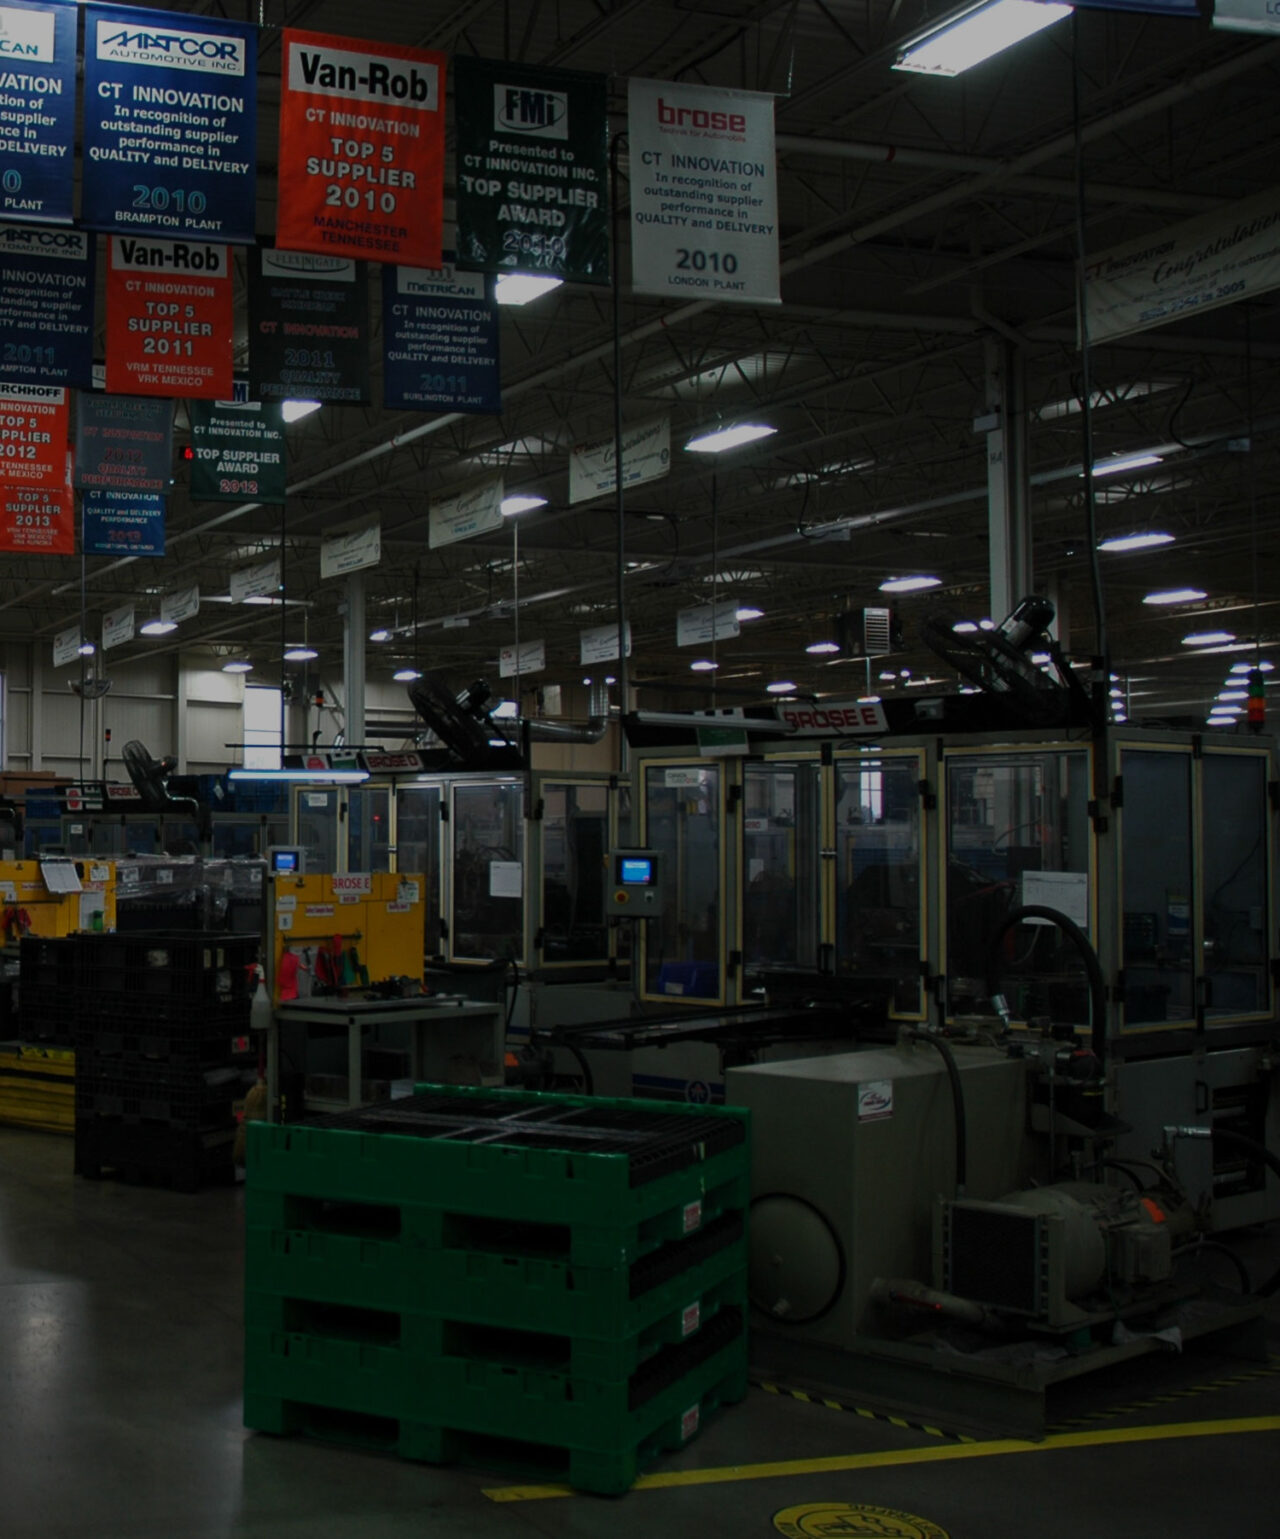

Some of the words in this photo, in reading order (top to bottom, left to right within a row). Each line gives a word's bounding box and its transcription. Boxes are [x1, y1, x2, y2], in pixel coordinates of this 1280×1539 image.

[103, 30, 238, 62] MATCOR
[110, 48, 206, 68] AUTOMOTIVE
[211, 61, 240, 72] INC.
[300, 52, 427, 101] Van-Rob
[29, 98, 43, 110] of
[98, 81, 123, 99] CT
[133, 85, 243, 113] INNOVATION
[1, 110, 56, 127] supplier
[306, 108, 326, 124] CT
[330, 111, 419, 138] INNOVATION
[657, 98, 745, 133] brose
[24, 127, 37, 138] in
[331, 138, 375, 159] TOP
[382, 145, 393, 162] 5
[489, 139, 556, 160] Presented
[560, 148, 574, 160] to
[307, 157, 416, 189] SUPPLIER
[464, 154, 482, 169] CT
[486, 156, 567, 179] INNOVATION
[572, 166, 599, 182] INC.
[641, 151, 663, 166] CT
[671, 154, 765, 178] INNOVATION
[133, 184, 206, 214] 2010
[326, 184, 397, 214] 2010
[464, 176, 501, 197] TOP
[508, 181, 598, 209] SUPPLIER
[5, 197, 43, 211] PLANT
[115, 210, 179, 227] BRAMPTON
[186, 217, 222, 231] PLANT
[497, 205, 565, 227] AWARD
[635, 212, 687, 228] QUALITY
[692, 218, 712, 229] and
[716, 220, 774, 235] DELIVERY
[314, 215, 408, 239] MANCHESTER
[320, 231, 400, 253] TENNESSEE
[120, 239, 219, 272] Van-Rob
[676, 249, 738, 274] 2010
[126, 280, 142, 292] CT
[146, 281, 215, 298] INNOVATION
[668, 275, 708, 288] LONDON
[713, 279, 745, 291] PLANT
[147, 302, 179, 317] TOP
[185, 304, 194, 317] 5
[128, 319, 212, 337] SUPPLIER
[3, 341, 56, 364] 2011
[143, 338, 193, 356] 2011
[127, 363, 149, 374] VRM
[153, 364, 214, 378] TENNESSEE
[138, 373, 160, 385] VRK
[164, 375, 202, 387] MEXICO
[420, 374, 466, 392] 2011
[30, 418, 37, 427] 5
[196, 448, 220, 459] TOP
[223, 450, 279, 463] SUPPLIER
[217, 461, 258, 473] AWARD
[220, 480, 258, 493] 2012
[16, 516, 50, 526] 2013
[784, 709, 860, 728] BROSE
[861, 708, 878, 725] E
[369, 755, 405, 768] BROSE
